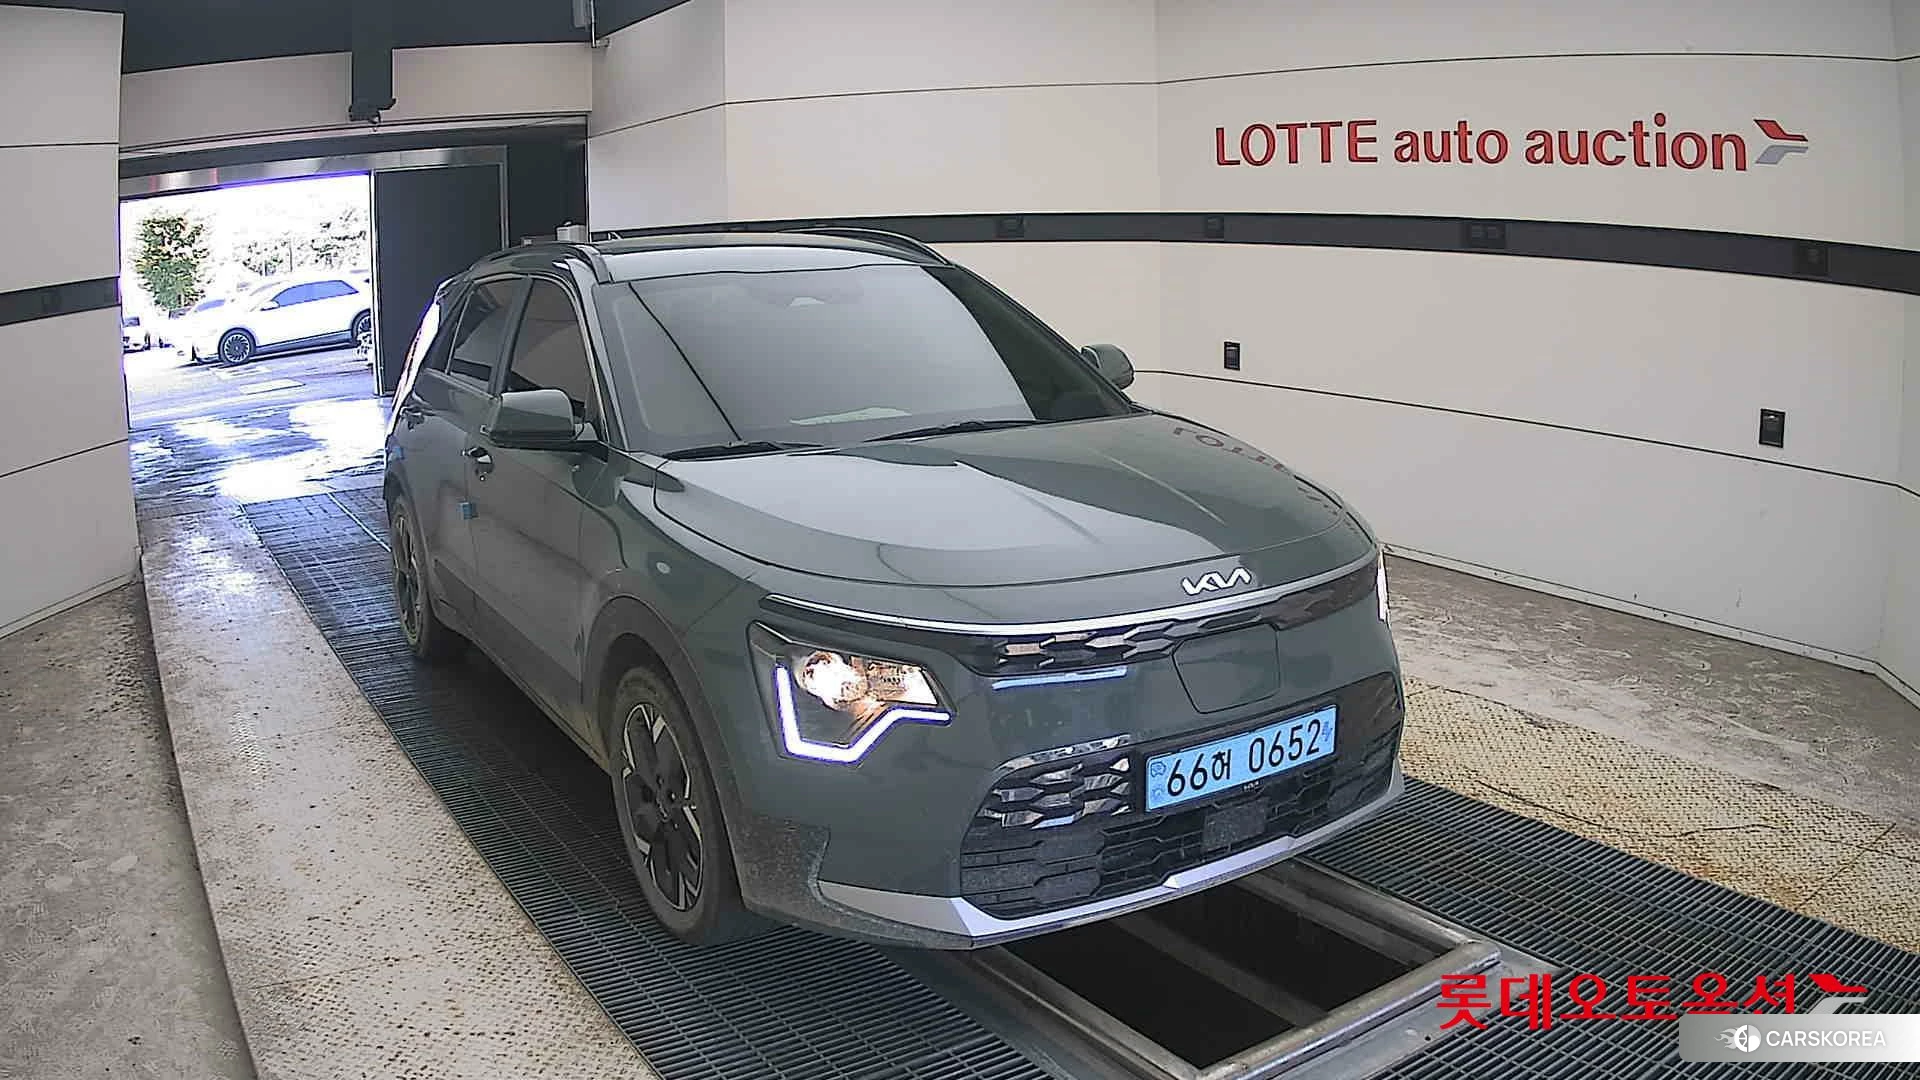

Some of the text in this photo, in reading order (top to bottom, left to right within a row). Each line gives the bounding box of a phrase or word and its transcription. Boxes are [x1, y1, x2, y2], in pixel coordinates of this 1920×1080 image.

[1215, 112, 1747, 172] LOTTE auto auction
[1166, 718, 1321, 797] 66허 0652
